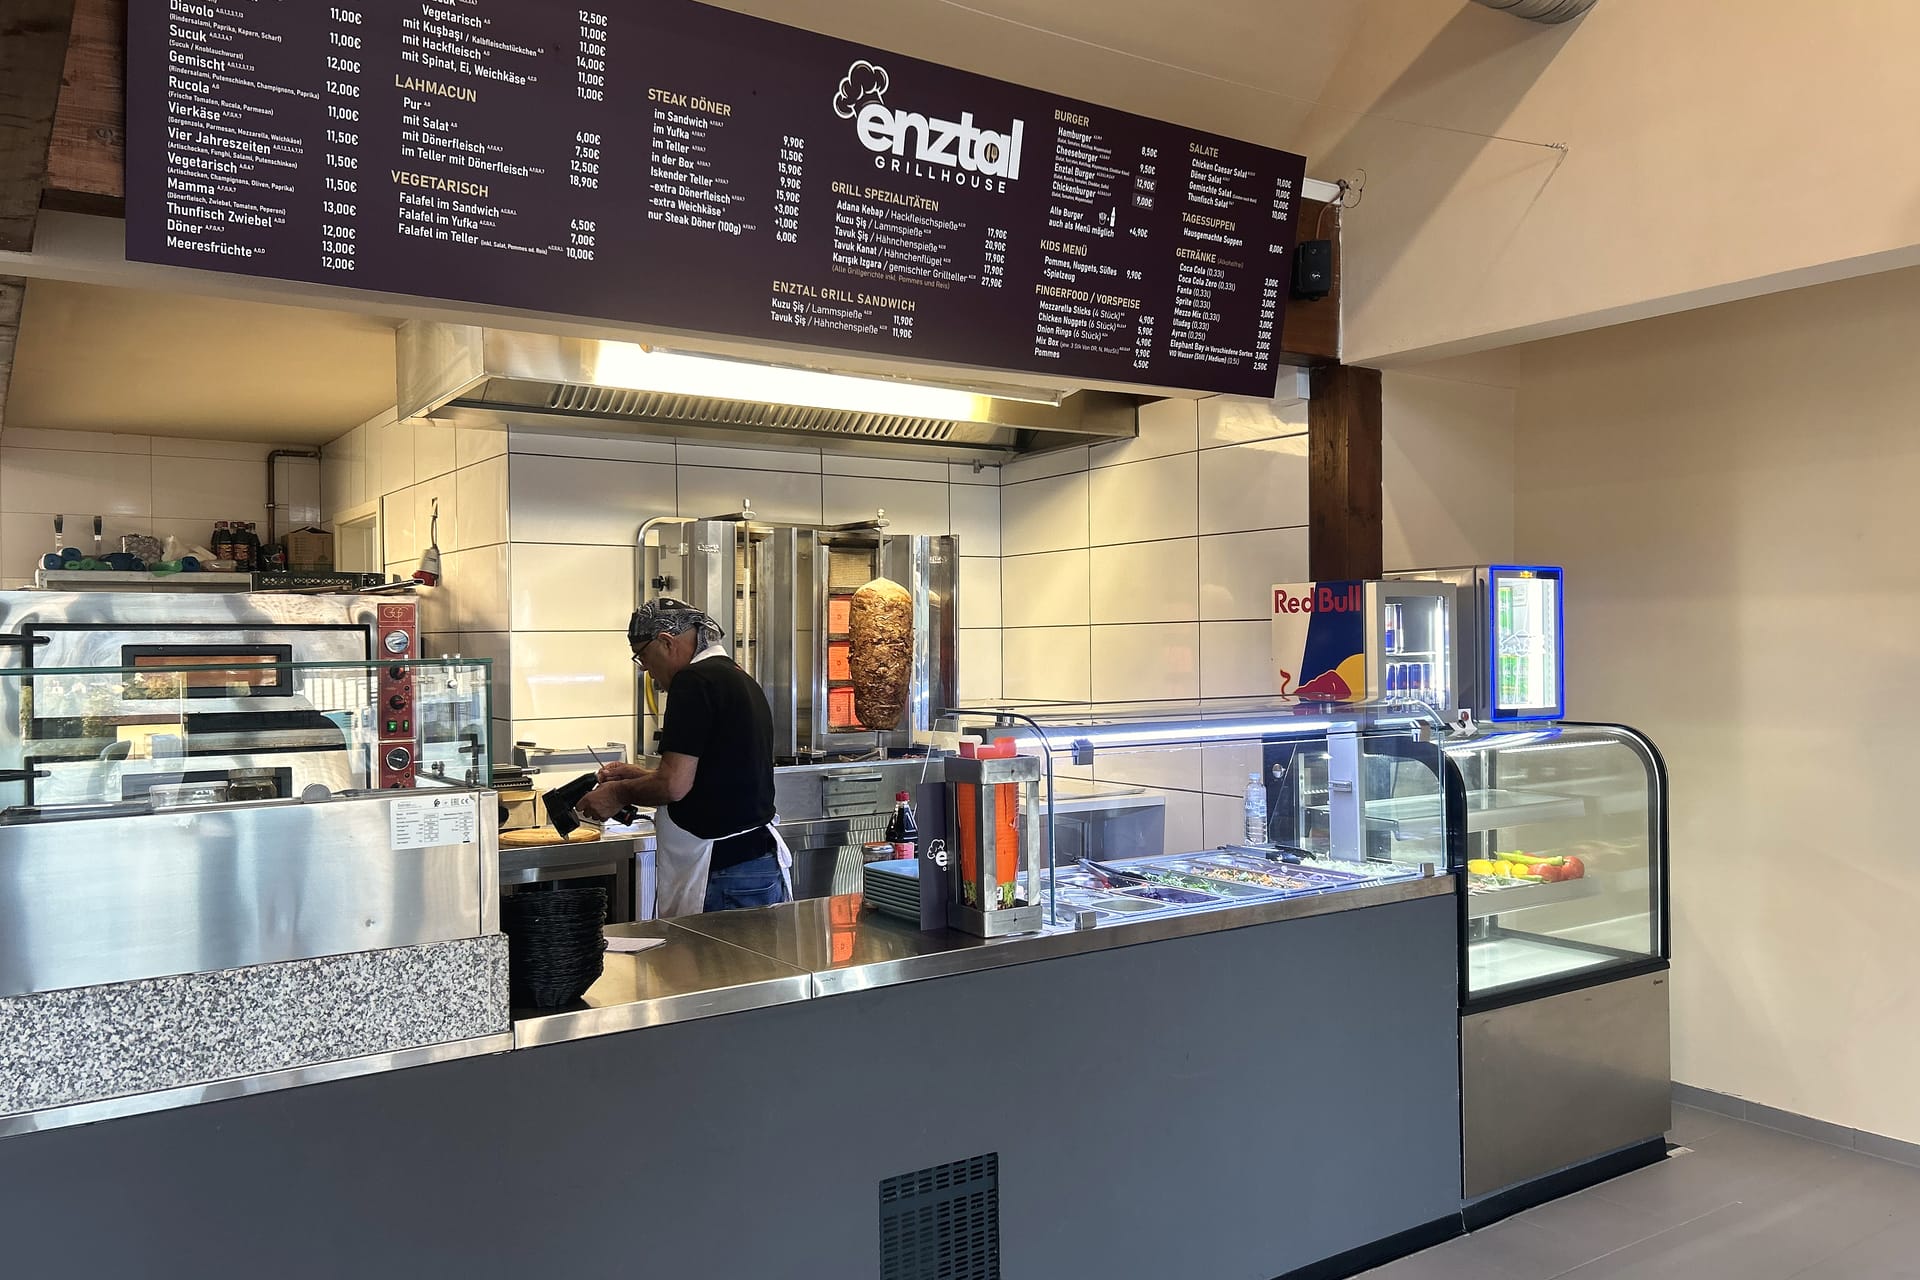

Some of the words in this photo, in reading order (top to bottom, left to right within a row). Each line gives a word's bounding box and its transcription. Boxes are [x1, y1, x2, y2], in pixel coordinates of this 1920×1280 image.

[170, 0, 213, 18] Diavolo
[330, 7, 362, 24] 11,00€
[422, 3, 481, 28] Vegetarisch
[578, 9, 607, 26] 12,50€
[169, 24, 206, 43] Sucuk
[402, 18, 420, 30] mit
[423, 20, 463, 42] Kuşbaşı
[580, 25, 606, 41] 11,00€
[329, 32, 361, 49] 11,00€
[402, 34, 419, 46] mit
[422, 36, 481, 60] Hackfleisch
[579, 41, 606, 56] 11,00€
[169, 49, 225, 71] Gemischt
[326, 56, 360, 73] 12,00€
[401, 50, 419, 62] mit
[422, 53, 457, 72] Spinat,
[459, 61, 471, 75] Ei,
[474, 63, 525, 85] Weichkäse
[576, 55, 605, 71] 14,00€
[169, 75, 209, 94] Rucola
[577, 71, 604, 86] 11,00€
[326, 80, 359, 97] 12,00€
[395, 73, 476, 102] LAHMACUN
[577, 86, 603, 101] 11,00€
[168, 100, 220, 121] Vierkäse
[403, 96, 422, 110] Pur
[647, 88, 687, 107] STEAK
[690, 96, 731, 116] DÖNER
[327, 105, 359, 121] 11,00€
[654, 108, 665, 120] im
[667, 111, 708, 129] Sandwich
[1054, 109, 1089, 127] BURGER
[403, 114, 419, 126] mit
[422, 116, 449, 132] Salat
[653, 122, 664, 134] im
[666, 125, 689, 139] Yufka
[168, 126, 192, 141] Vier
[195, 131, 270, 154] Jahreszeiten
[326, 129, 358, 145] 11,50€
[402, 130, 419, 142] mit
[422, 132, 485, 154] Dönerfleisch
[576, 131, 600, 145] 6,00€
[652, 136, 663, 149] im
[665, 139, 689, 153] Teller
[783, 135, 804, 149] 9,90€
[856, 103, 1024, 180] enztal
[575, 145, 600, 159] 7,50€
[780, 148, 803, 162] 11,50€
[1188, 142, 1219, 158] SALATE
[167, 151, 237, 174] Vegetarisch
[326, 153, 358, 169] 11,50€
[401, 144, 414, 157] im
[416, 146, 446, 162] Teller
[448, 154, 465, 165] mit
[467, 156, 528, 177] Dönerfleisch
[570, 159, 599, 174] 12,50€
[651, 151, 659, 162] in
[661, 153, 676, 166] der
[678, 156, 694, 169] Box
[778, 161, 802, 176] 15,90€
[569, 174, 598, 189] 18,90€
[650, 165, 688, 182] Iskender
[689, 172, 713, 186] Teller
[780, 176, 801, 189] 9,90€
[874, 155, 1006, 193] GRILLHOUSE
[167, 176, 214, 195] Mamma
[325, 177, 357, 192] 11,50€
[391, 169, 488, 198] VEGETARISCH
[649, 183, 676, 194] -extra
[678, 185, 730, 204] Dönerfleisch
[775, 189, 800, 203] 15,90€
[831, 180, 861, 197] GRILL
[864, 187, 938, 212] SPEZIALITÄTEN
[323, 200, 356, 216] 13,00€
[399, 191, 434, 207] Falafel
[437, 197, 449, 210] im
[452, 200, 499, 217] Sandwich
[648, 197, 675, 208] -extra
[677, 199, 721, 216] Weichkäse
[773, 203, 799, 216] +3,00€
[836, 199, 859, 212] Adana
[861, 203, 883, 219] Kebap
[166, 201, 224, 221] Thunfisch
[228, 210, 272, 227] Zwiebel
[399, 207, 433, 223] Falafel
[436, 212, 448, 225] im
[451, 215, 478, 229] Yufka
[647, 210, 663, 220] nur
[664, 211, 689, 225] Steak
[690, 215, 716, 229] Döner
[717, 219, 741, 235] (100g)
[1181, 211, 1235, 231] TAGESSUPPEN
[167, 218, 203, 234] Döner
[322, 224, 356, 239] 12,00€
[570, 218, 596, 232] 6,50€
[774, 217, 798, 230] +1,00€
[398, 222, 433, 238] Falafel
[435, 228, 448, 240] im
[450, 230, 479, 244] Teller
[570, 232, 595, 246] 7,00€
[776, 230, 797, 243] 6,00€
[167, 235, 252, 257] Meeresfrüchte
[322, 240, 355, 255] 13,00€
[566, 247, 594, 260] 10,00€
[1040, 239, 1060, 251] KIDS
[1062, 242, 1087, 256] MENÜ
[321, 256, 354, 270] 12,00€
[1175, 247, 1216, 263] GETRÄNKE
[772, 280, 817, 297] ENZTAL
[820, 287, 853, 302] GRILL
[856, 293, 915, 311] SANDWICH
[1035, 283, 1088, 301] FINGERFOOD
[1096, 293, 1140, 309] VORSPEISE
[893, 314, 913, 326] 11,90€
[892, 327, 912, 338] 11,90€
[1274, 586, 1315, 613] Red
[1318, 584, 1361, 612] Bull
